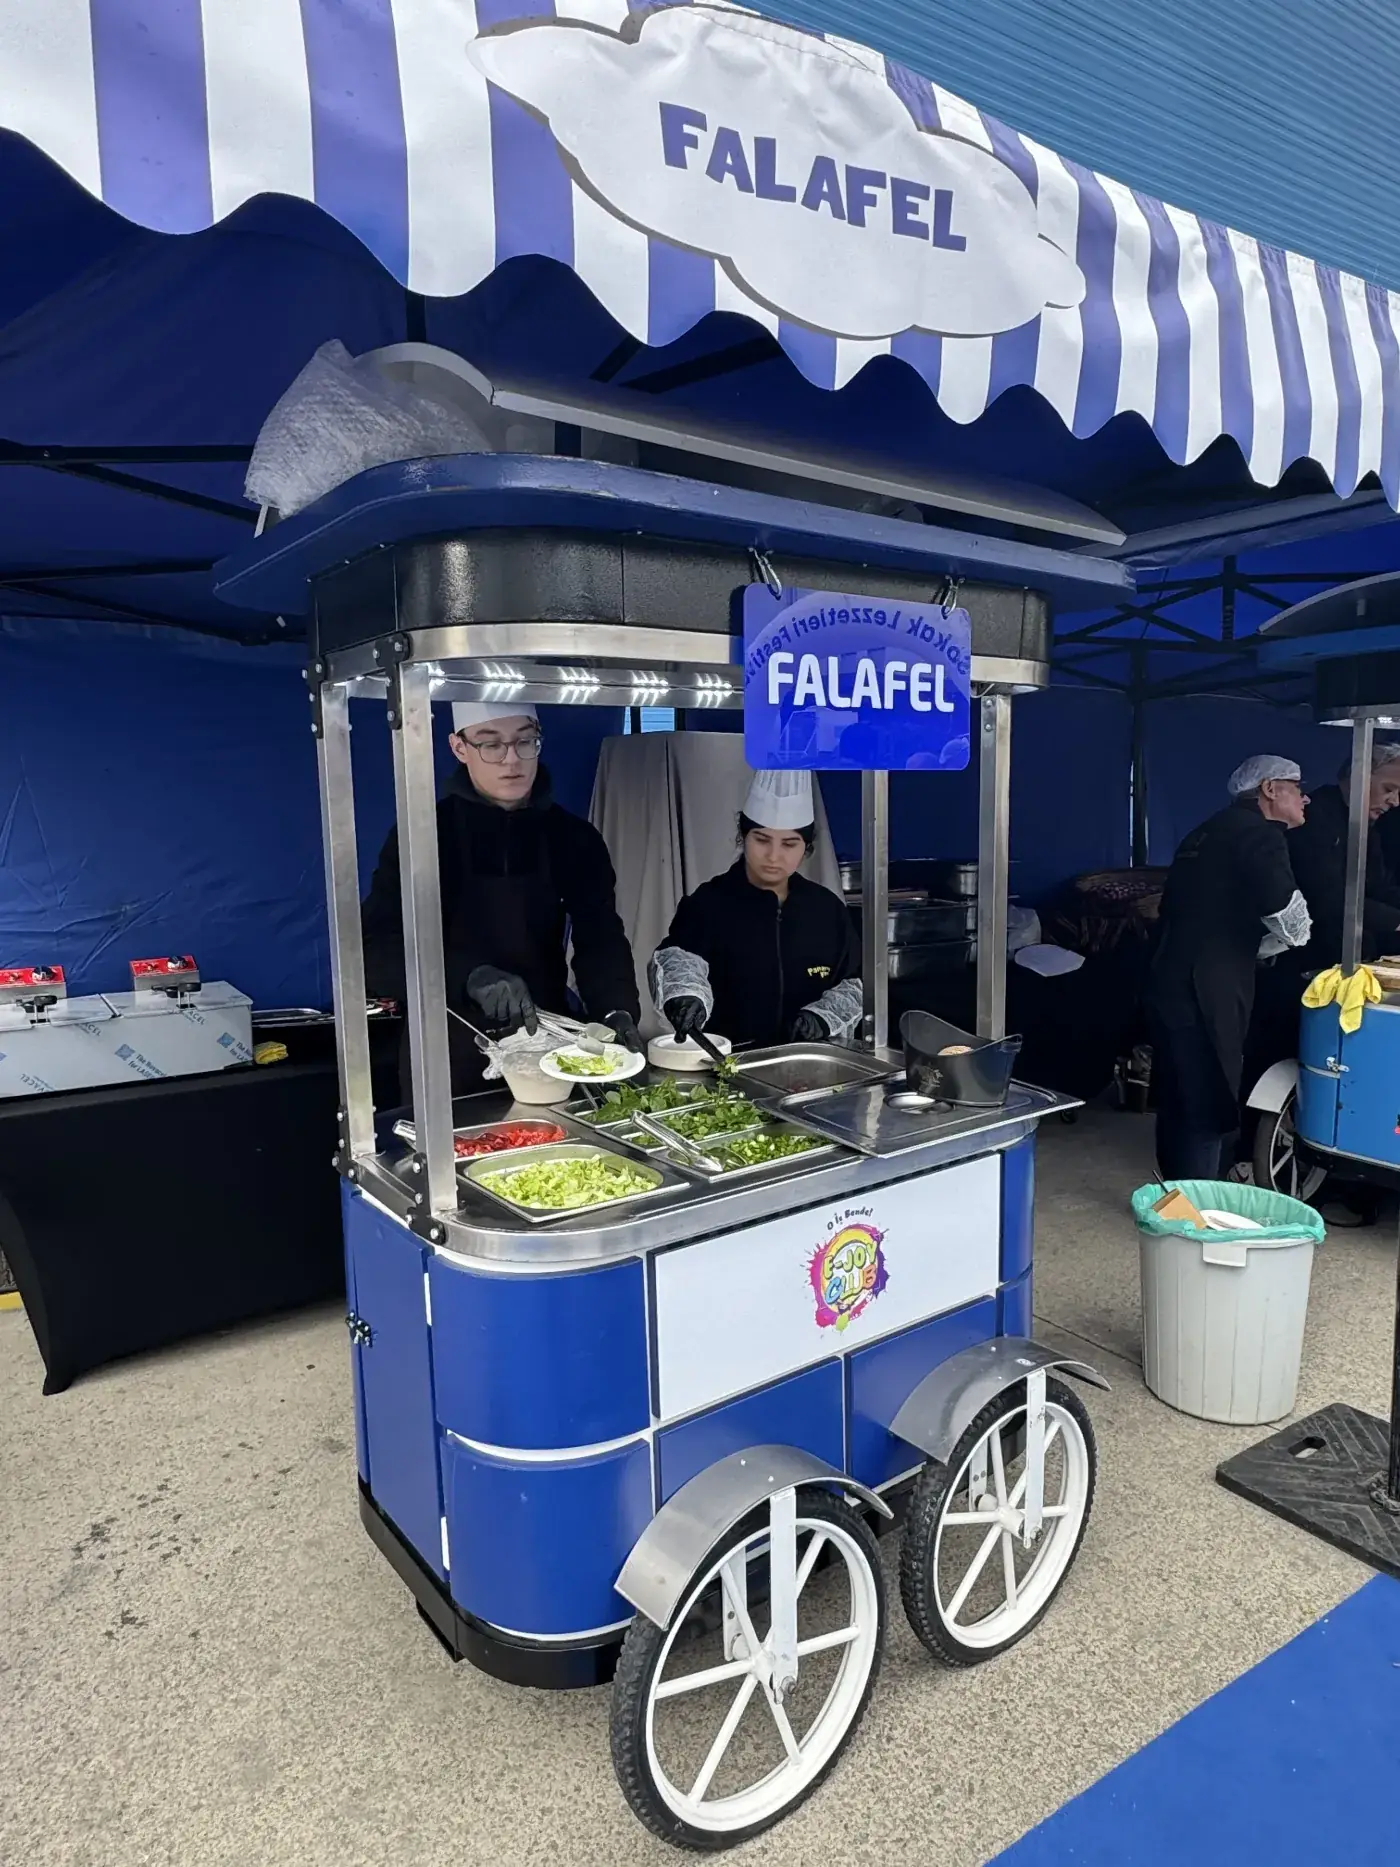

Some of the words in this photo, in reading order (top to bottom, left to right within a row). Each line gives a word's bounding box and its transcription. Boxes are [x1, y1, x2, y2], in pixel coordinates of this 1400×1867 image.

[659, 101, 967, 252] FALAFEL
[768, 651, 955, 713] FALAFEL
[827, 1221, 834, 1230] O
[844, 1206, 874, 1219] Bende!
[823, 1240, 878, 1280] E-JOY
[824, 1264, 877, 1305] CLUB
